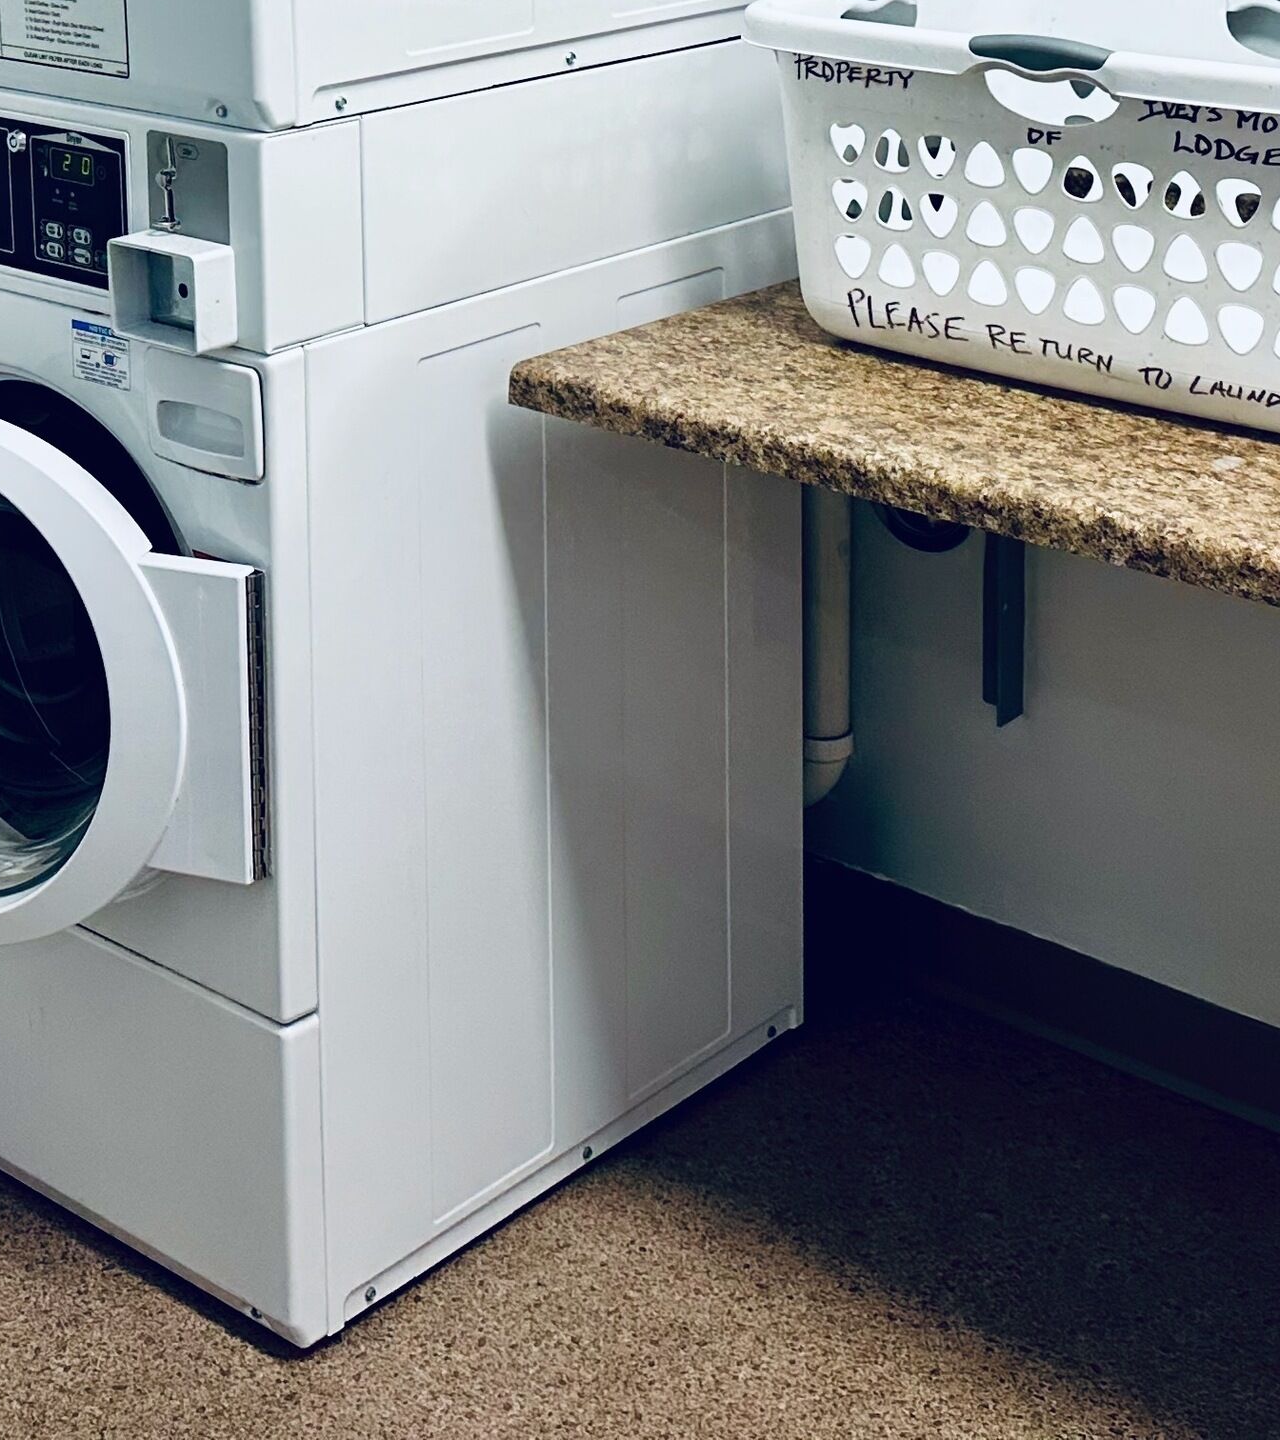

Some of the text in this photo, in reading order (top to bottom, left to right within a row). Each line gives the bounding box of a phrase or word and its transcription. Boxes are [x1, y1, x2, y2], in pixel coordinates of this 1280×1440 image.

[1027, 127, 1062, 145] OF
[847, 288, 969, 342] PLEASE
[986, 324, 1113, 373] RETURN
[1138, 366, 1173, 390] TO
